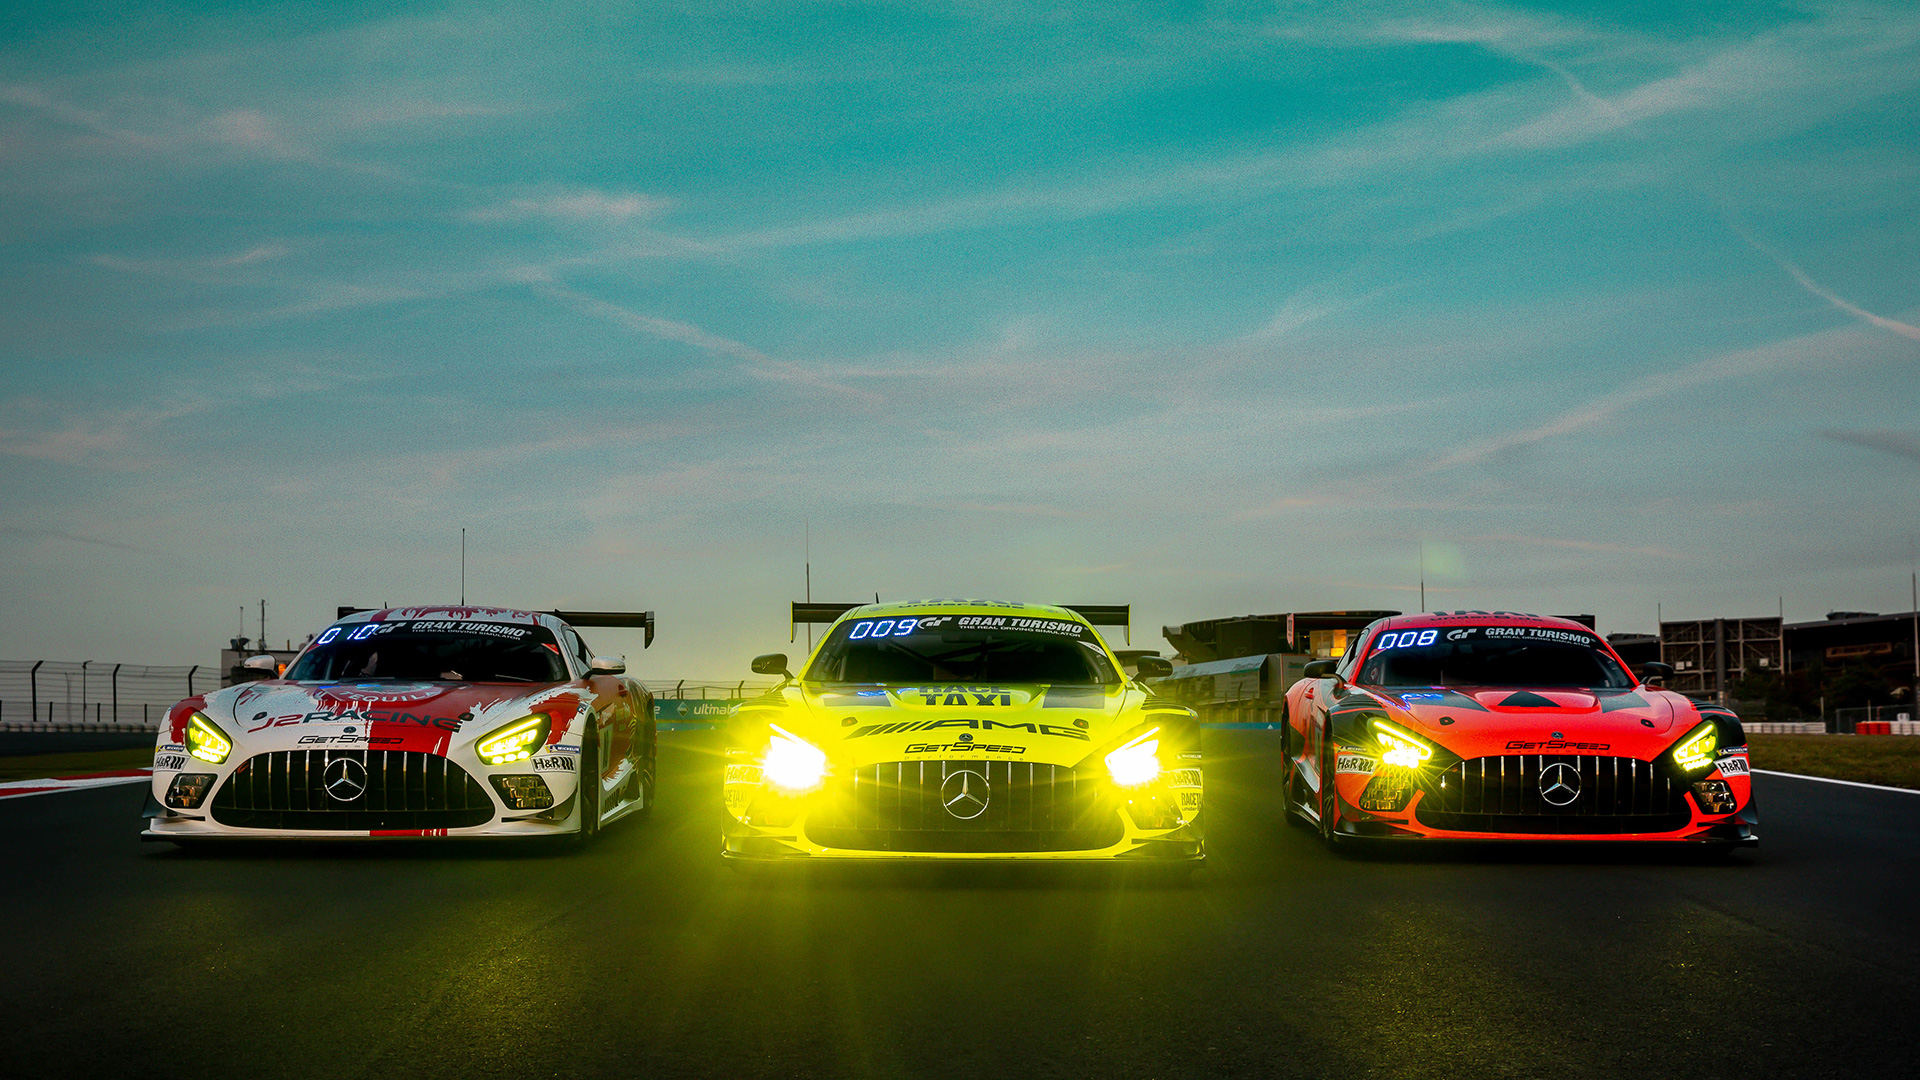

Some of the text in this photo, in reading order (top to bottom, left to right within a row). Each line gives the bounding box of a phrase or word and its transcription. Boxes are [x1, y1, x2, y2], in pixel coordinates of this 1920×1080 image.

[411, 621, 457, 630] GRAN
[459, 621, 526, 637] TURISMO
[849, 618, 918, 639] 009
[958, 616, 1006, 626] GRAN
[1010, 618, 1083, 634] TURISMO
[318, 624, 380, 645] 010
[478, 631, 521, 641] SIMULATOR
[1034, 628, 1081, 638] SIMULATOR
[1378, 630, 1438, 650] 008
[1485, 627, 1526, 636] GRAN
[1528, 628, 1591, 644] TURISMO
[340, 690, 439, 702] TEQUILA
[919, 693, 1011, 706] TAXI
[533, 756, 561, 769] H&R
[1337, 757, 1358, 769] H&R
[1718, 759, 1741, 774] H&R
